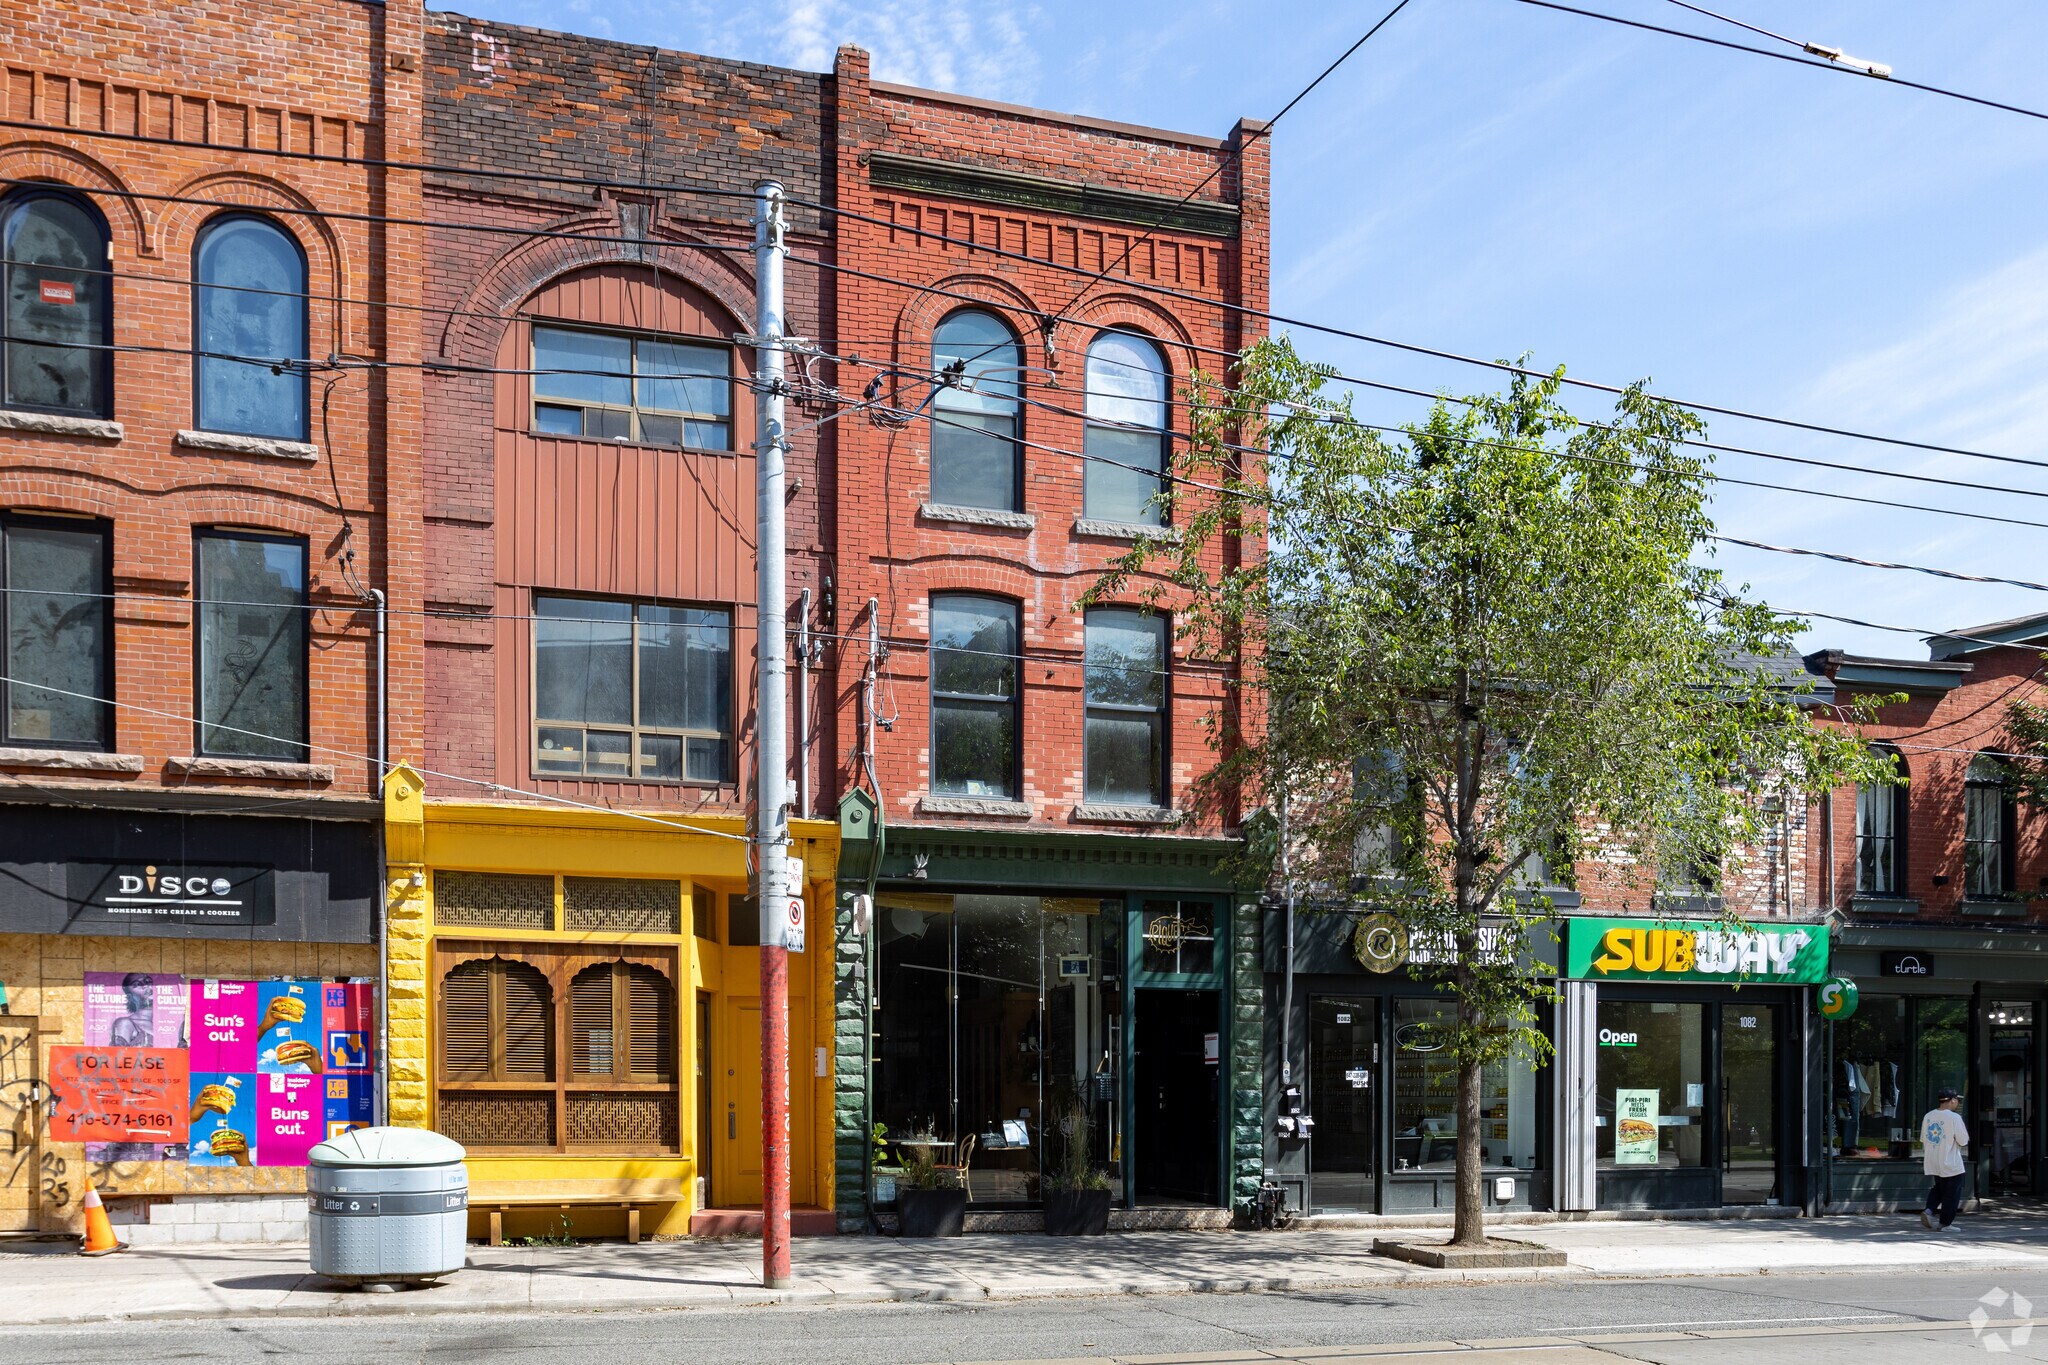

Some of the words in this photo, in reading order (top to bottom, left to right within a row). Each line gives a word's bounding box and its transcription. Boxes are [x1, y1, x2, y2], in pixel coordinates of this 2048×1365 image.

[1373, 934, 1388, 953] R
[1592, 927, 1812, 976] SUBWAY
[1895, 956, 1927, 974] turtle
[88, 984, 105, 994] THE
[156, 985, 173, 995] THE
[88, 994, 128, 1004] CULTURE
[204, 1013, 245, 1028] Sun's
[1740, 1016, 1757, 1028] 1082
[88, 1024, 108, 1032] AGO
[208, 1029, 240, 1042] out.
[1599, 1028, 1638, 1047] Open
[76, 1056, 110, 1069] FOR
[114, 1056, 165, 1070] LEASE
[66, 1113, 174, 1127] 416-574-6161
[271, 1107, 310, 1121] Buns
[274, 1122, 306, 1135] out.
[323, 1198, 344, 1210] Litter
[446, 1196, 462, 1208] Litter
